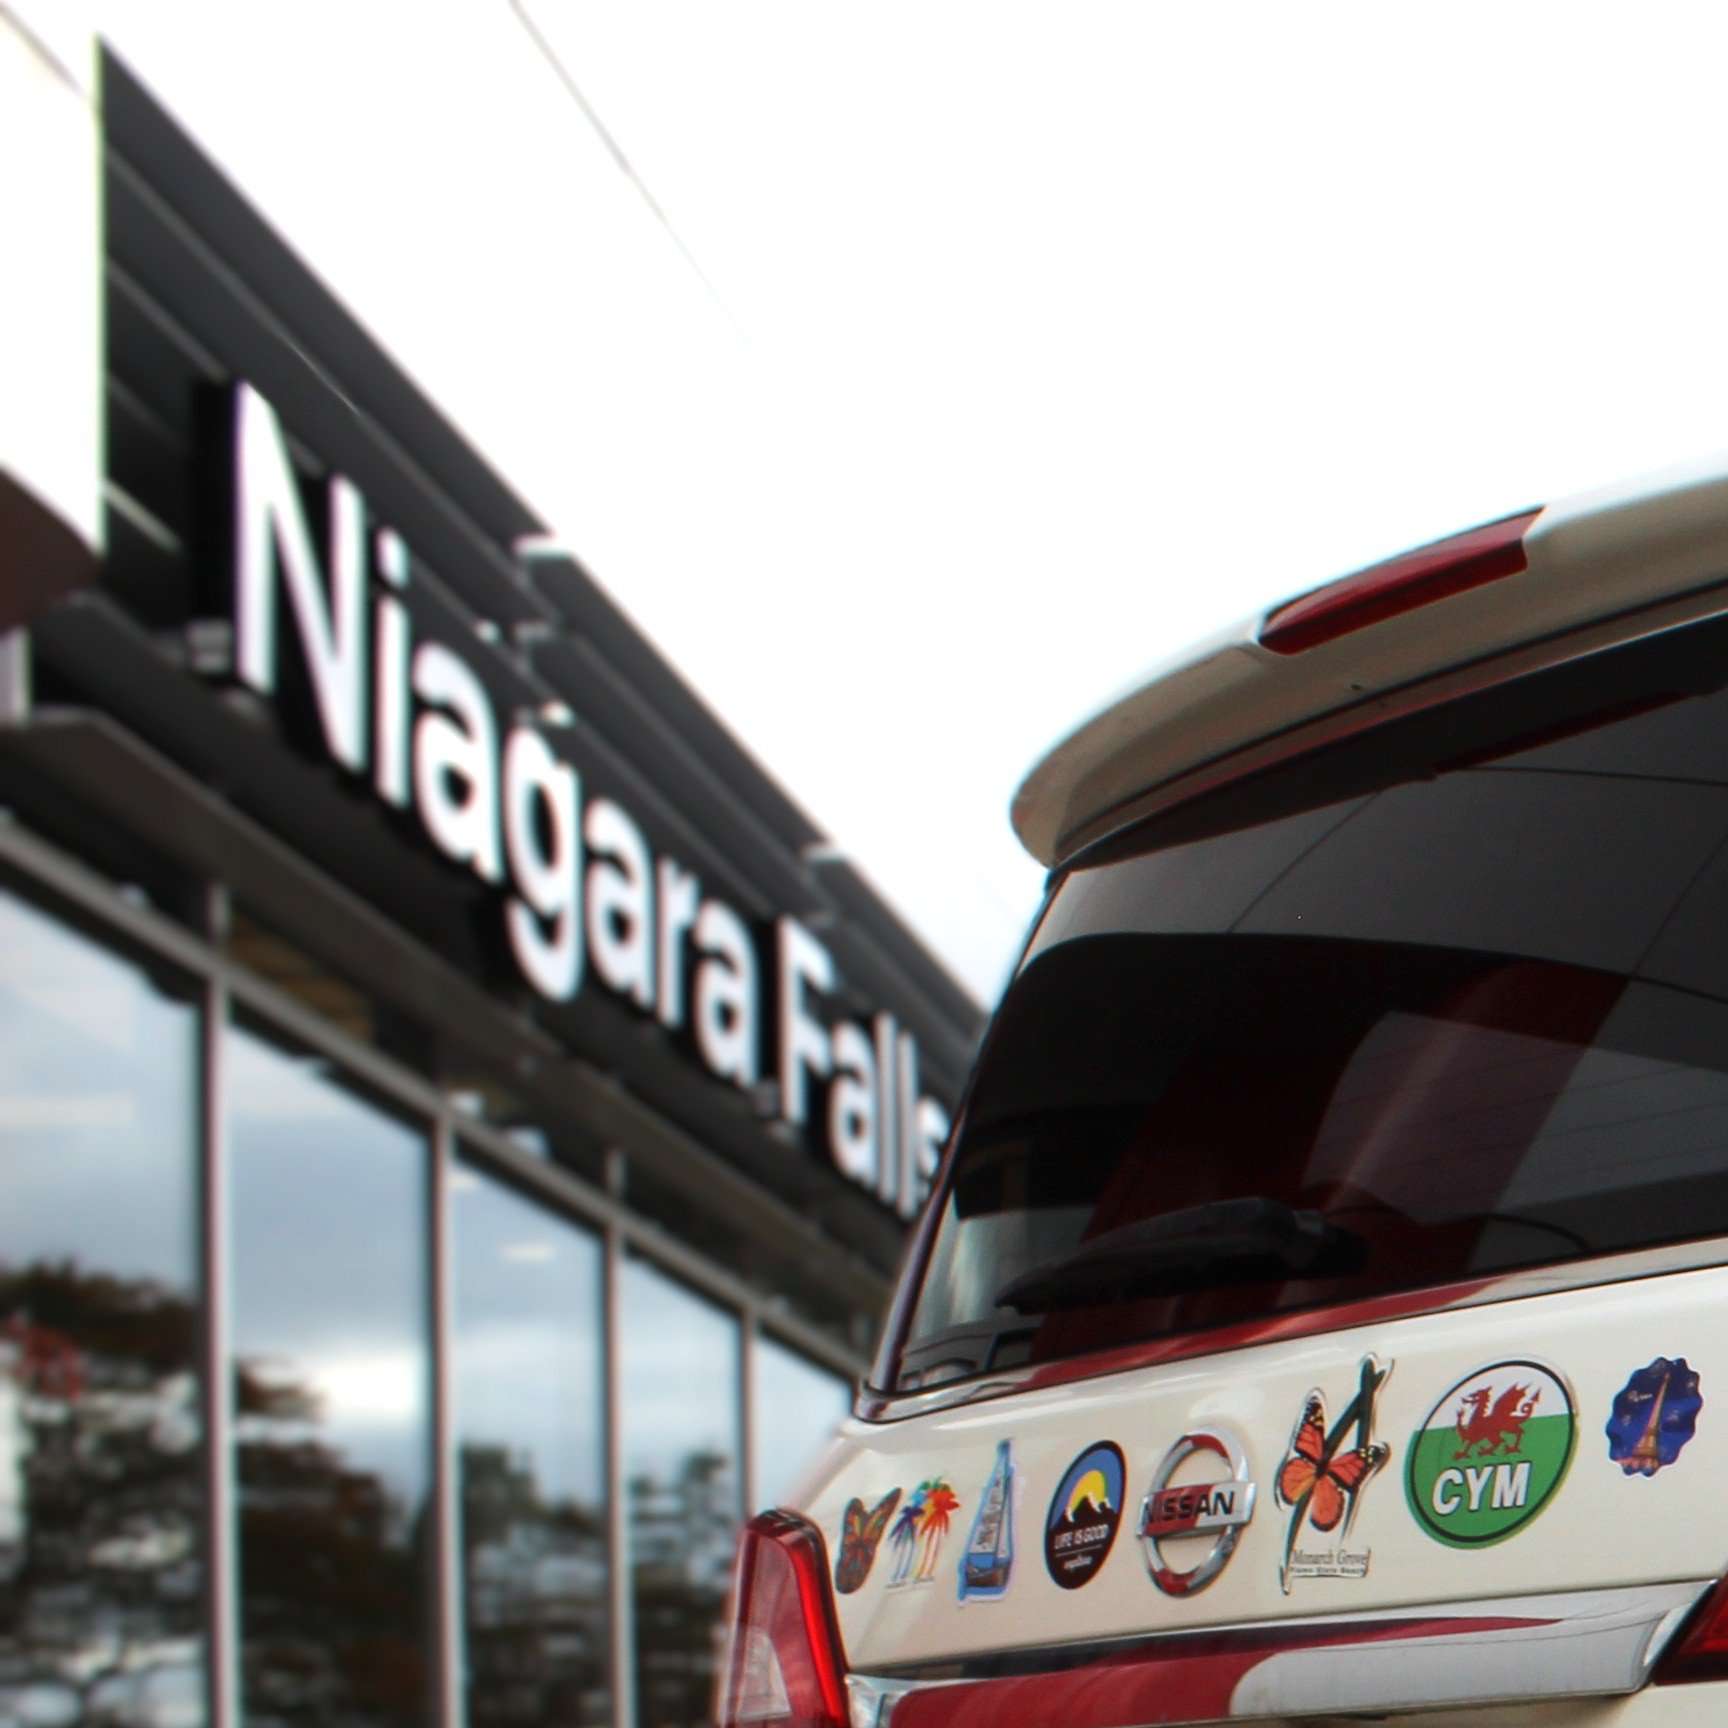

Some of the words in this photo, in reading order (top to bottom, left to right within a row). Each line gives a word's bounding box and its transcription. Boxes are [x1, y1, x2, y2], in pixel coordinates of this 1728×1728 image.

[234, 380, 763, 1090] Niagara
[1147, 1490, 1235, 1525] NISSAN
[1432, 1462, 1532, 1516] CYM
[1054, 1532, 1072, 1549] LIFE
[1074, 1529, 1083, 1545] IS
[1084, 1524, 1109, 1543] GOOD
